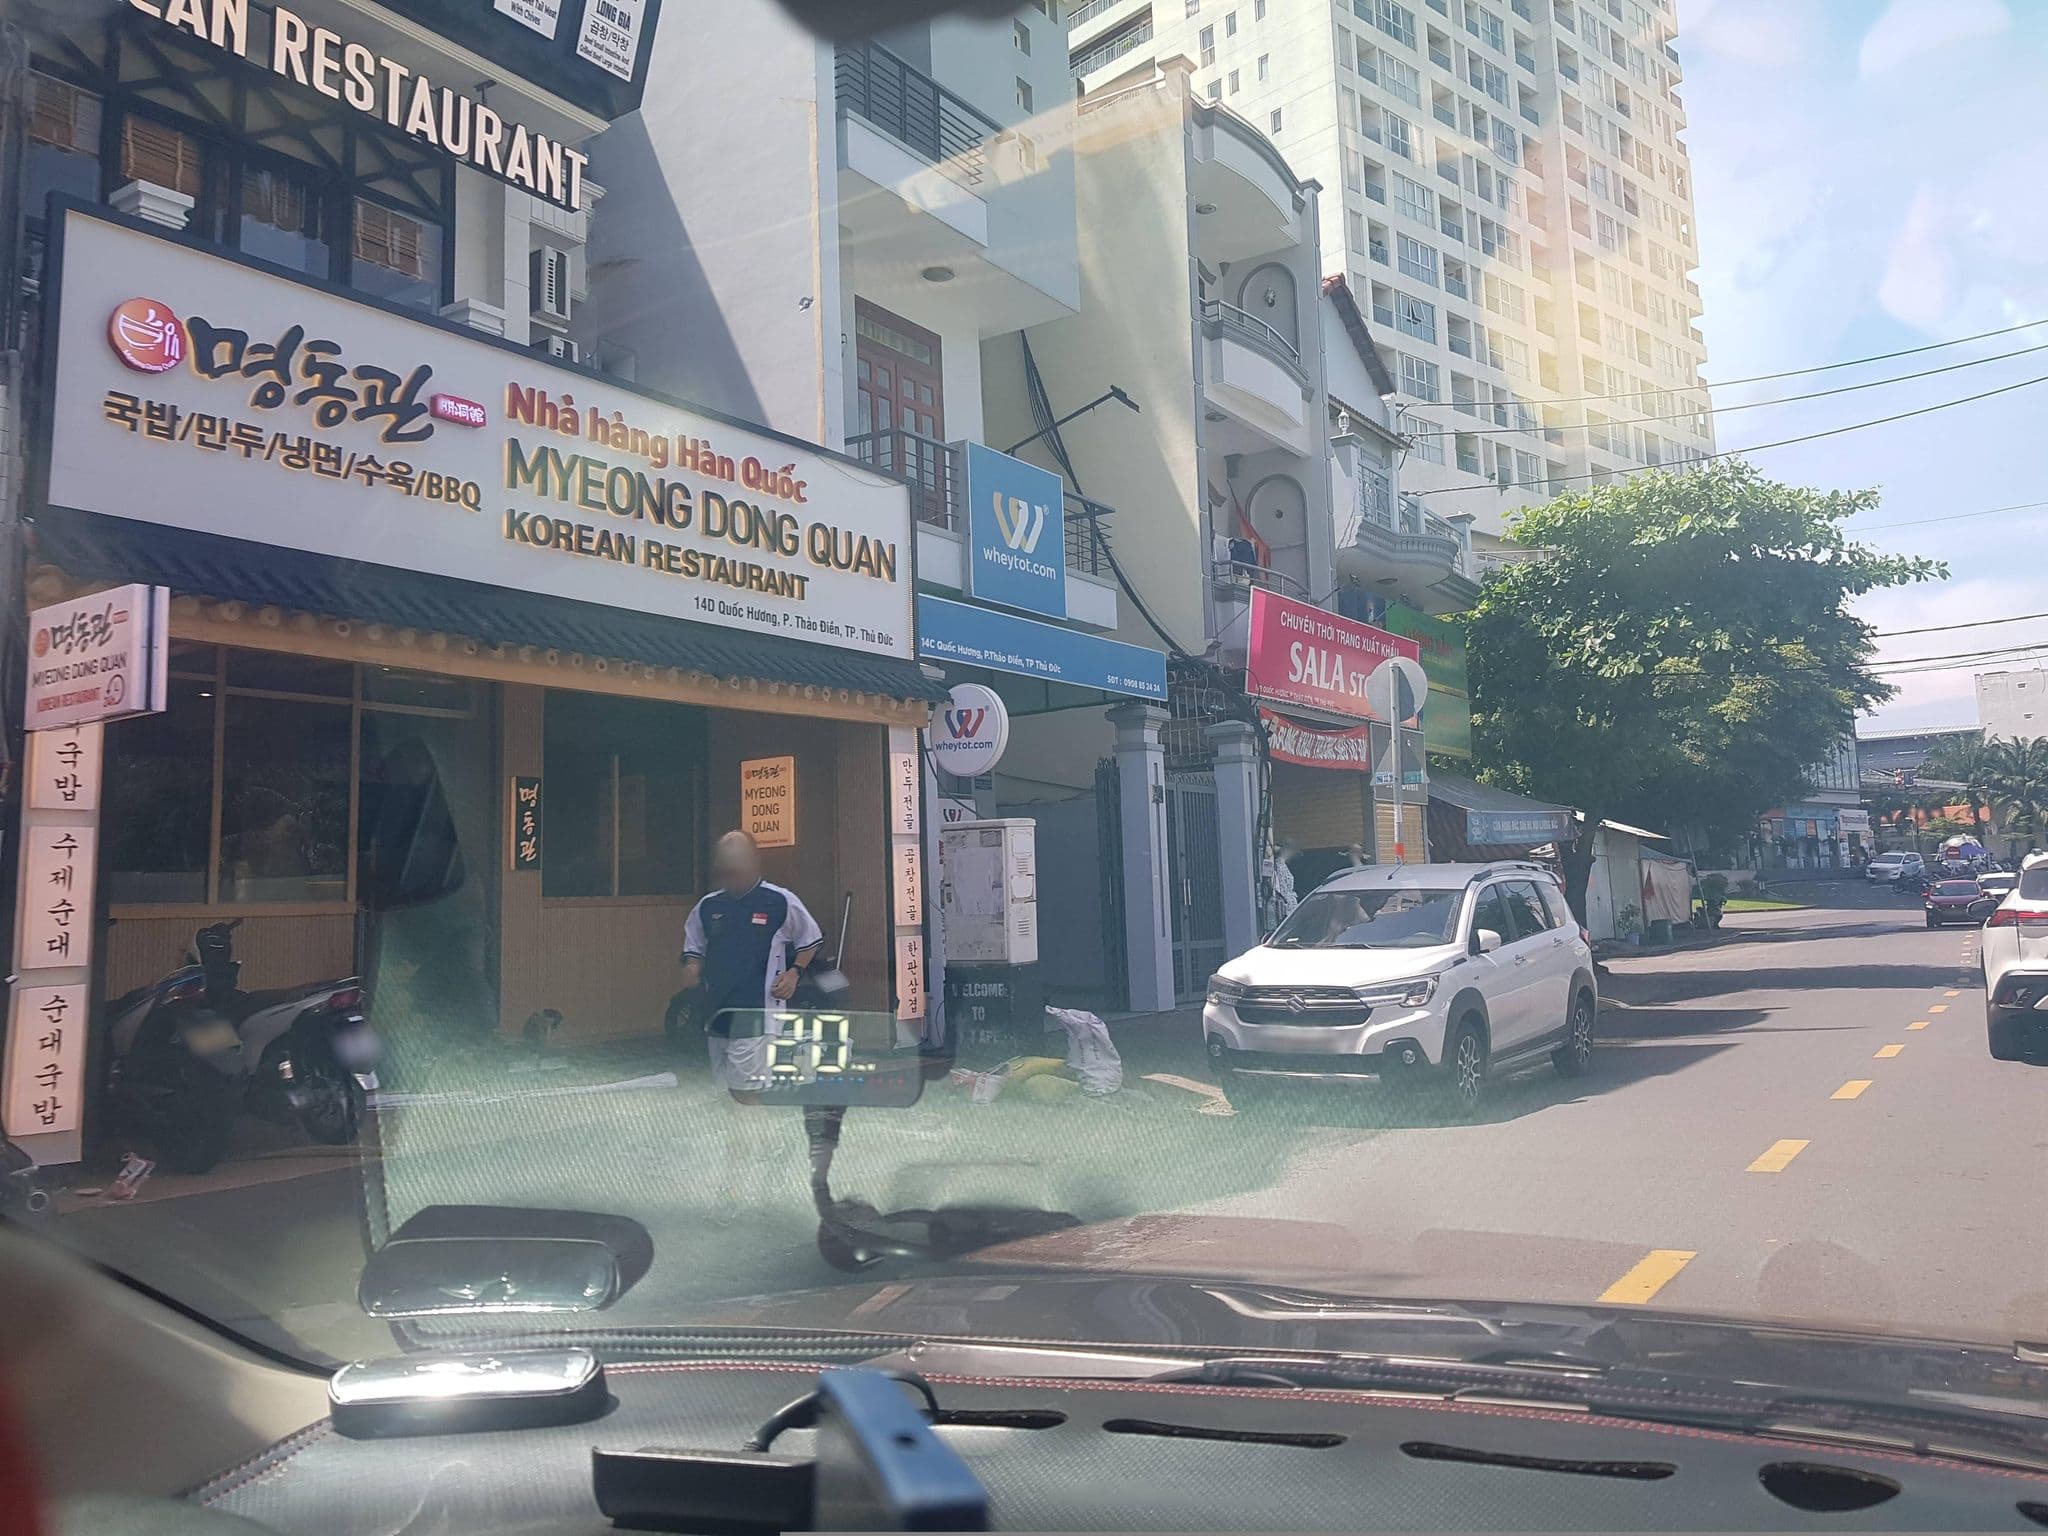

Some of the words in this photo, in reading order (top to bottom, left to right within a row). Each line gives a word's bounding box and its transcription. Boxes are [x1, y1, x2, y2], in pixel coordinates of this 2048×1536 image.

[511, 1, 524, 17] With
[523, 8, 542, 26] Chives
[590, 20, 630, 52] 곱창/막창
[274, 6, 588, 211] RESTAURANT
[187, 316, 436, 445] 명동관
[103, 390, 482, 512] 국밥/만두/냉면/수육/BBQ
[507, 382, 580, 436] Nhà
[588, 404, 669, 469] hàng
[677, 433, 735, 482] Hàn
[741, 455, 808, 504] Quốc
[506, 437, 693, 530] MYEONG
[701, 489, 799, 558] DONG
[807, 521, 897, 583] QUAN
[506, 508, 636, 565] KOREAN
[643, 538, 809, 601] RESTAURANT
[983, 546, 1057, 581] wheytot.com
[51, 602, 114, 655] 명동관
[694, 595, 715, 612] 14D
[718, 601, 744, 619] Quốc
[747, 606, 781, 627] Hương,
[783, 613, 793, 628] P.
[795, 615, 818, 632] Thảo
[845, 625, 859, 640] TP.
[861, 628, 876, 643] Thủ
[877, 631, 894, 647] Đức
[1280, 611, 1315, 635] CHUYÊN
[1317, 621, 1335, 642] THỜI
[1336, 629, 1361, 649] TRANG
[1361, 634, 1379, 655] XUẤT
[1380, 639, 1400, 658] KHẨU
[32, 665, 71, 688] MYEONG
[71, 659, 99, 679] DONG
[100, 651, 128, 673] QUAN
[921, 637, 935, 649] 14C
[937, 640, 957, 653] Quốc
[958, 643, 983, 660] Hương,
[1025, 658, 1035, 668] TP
[1288, 641, 1345, 694] SALA
[751, 764, 781, 780] 명동관
[935, 740, 993, 752] wheytot.com
[745, 785, 786, 801] MYEONG
[751, 803, 780, 817] DONG
[902, 757, 915, 830] 만두전골
[519, 783, 539, 862] 명동관
[752, 820, 780, 834] QUAN
[47, 833, 80, 959] 수제순대
[33, 995, 69, 1126] 순대국밥
[767, 1013, 851, 1074] 20
